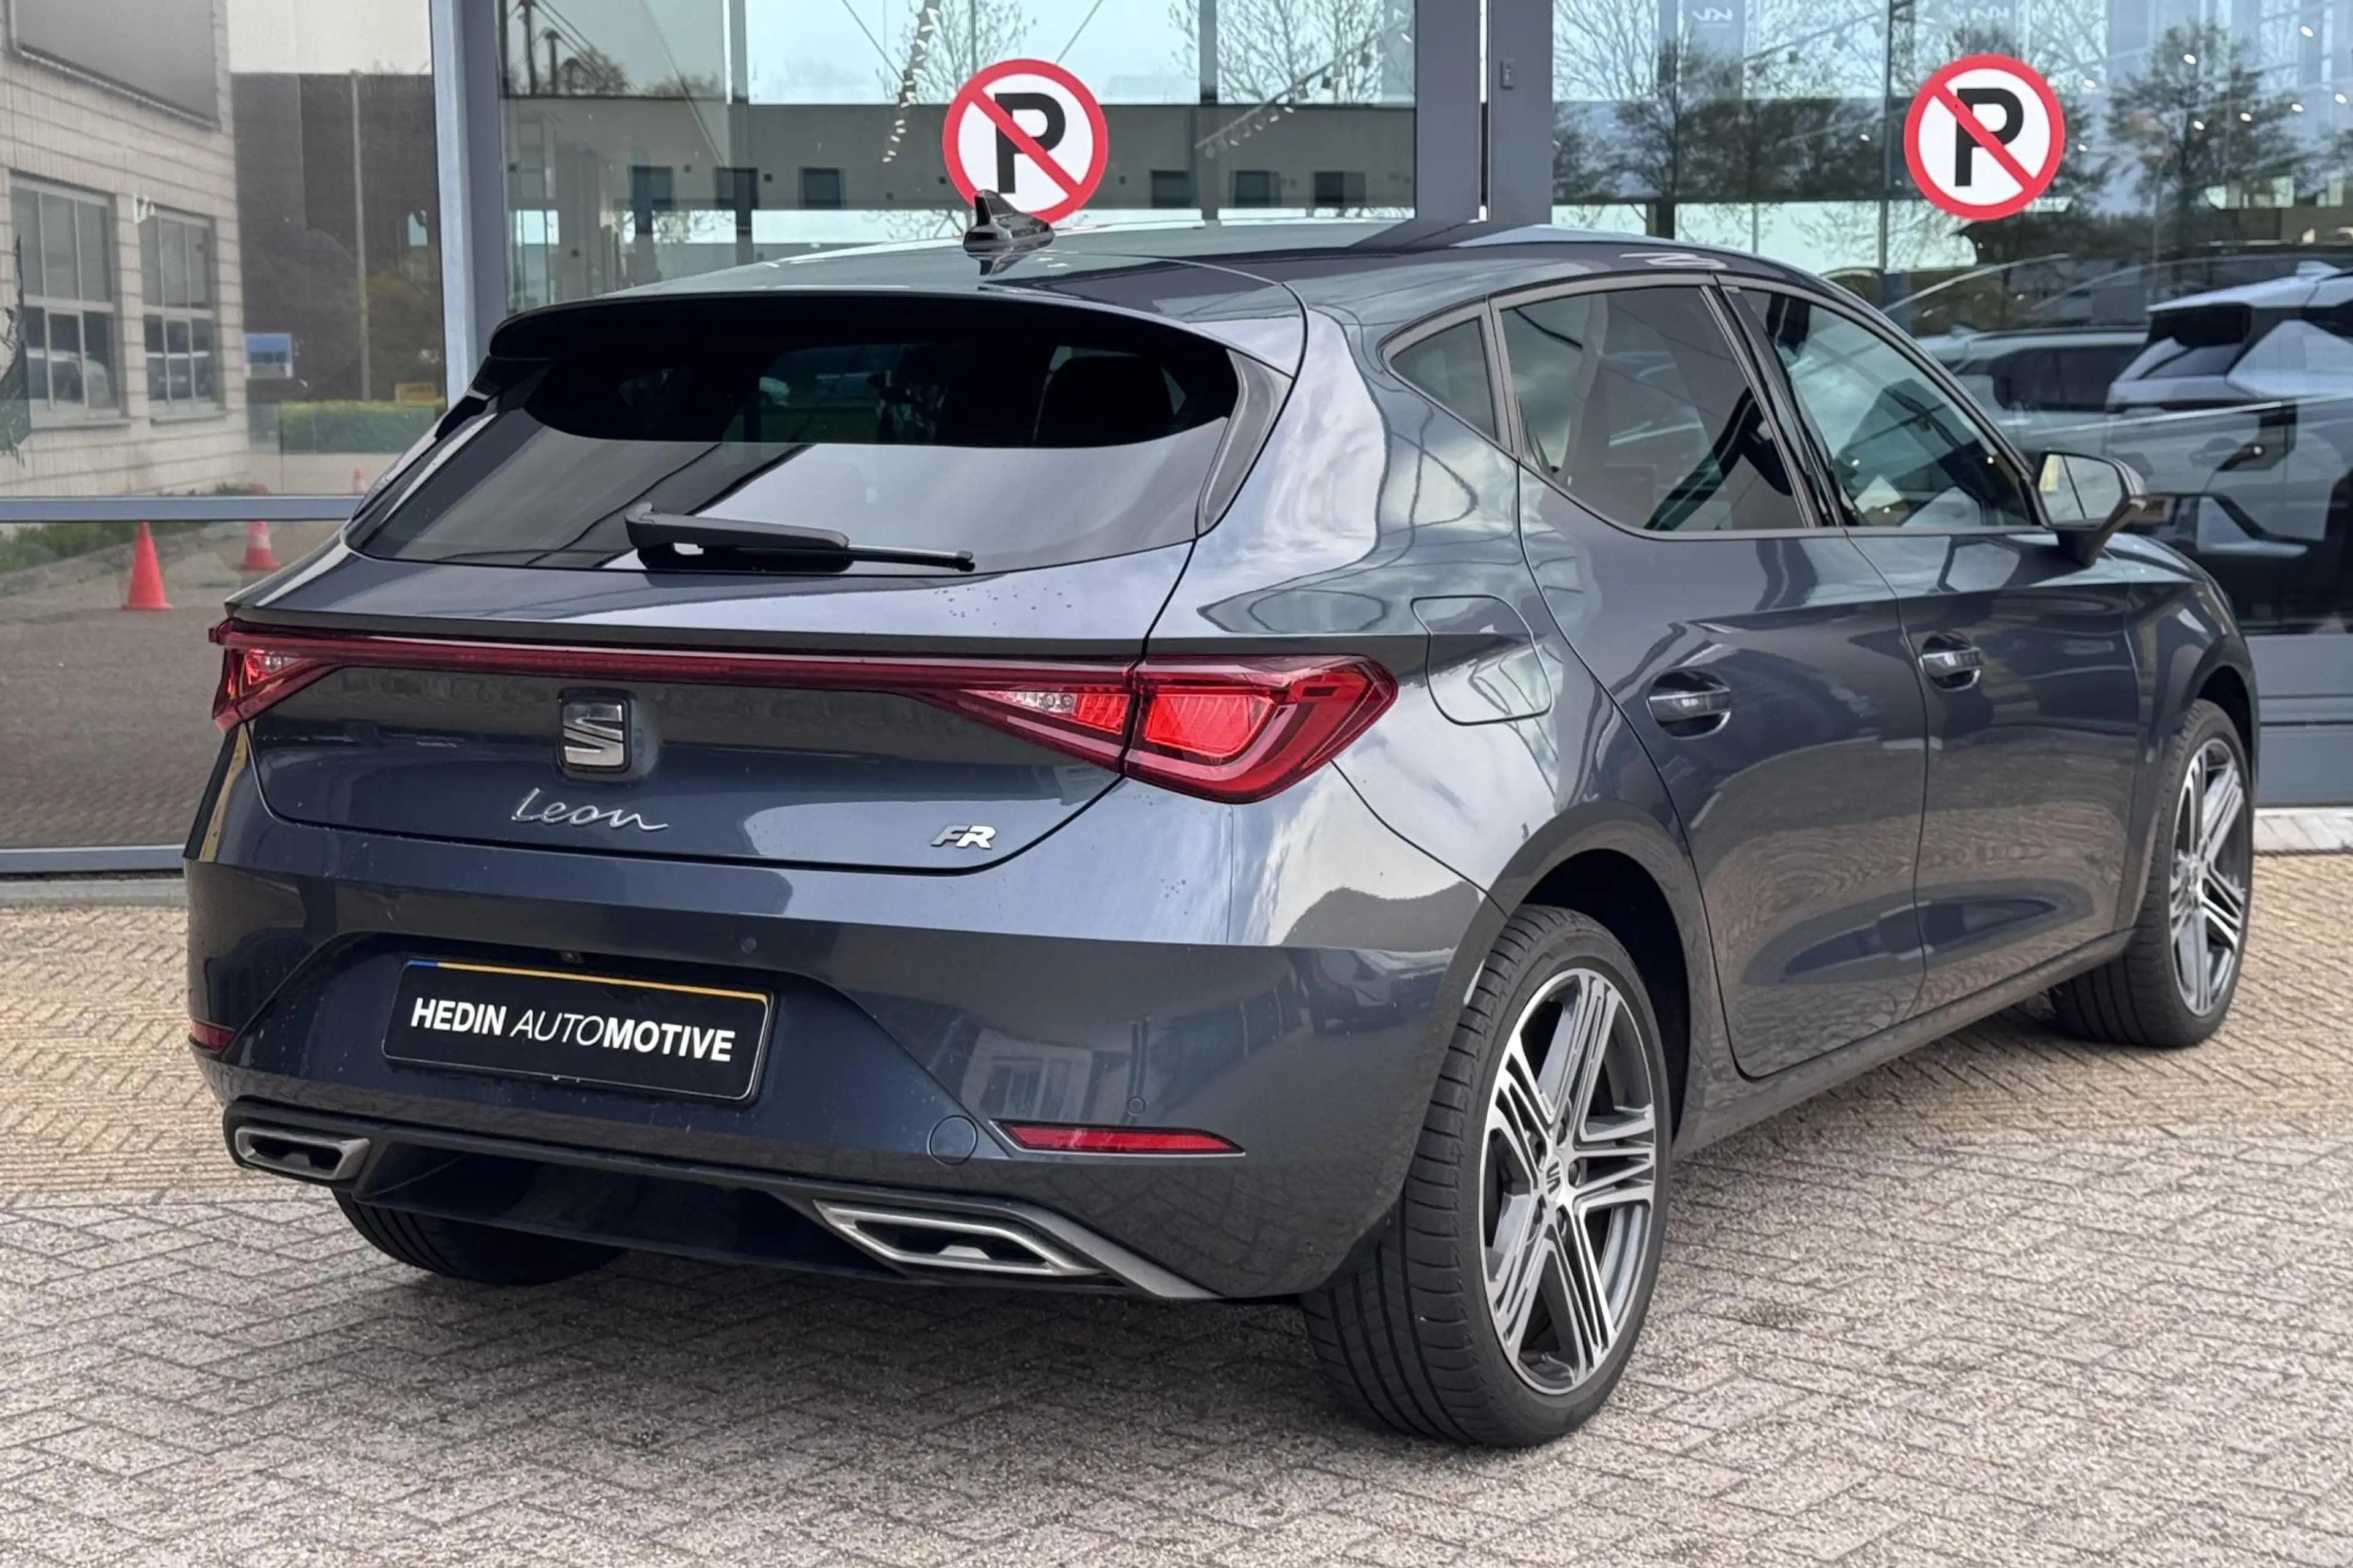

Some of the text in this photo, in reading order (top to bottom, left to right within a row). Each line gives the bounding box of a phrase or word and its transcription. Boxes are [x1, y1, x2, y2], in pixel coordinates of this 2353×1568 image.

[994, 93, 1066, 194] P
[1955, 88, 2023, 186] P
[512, 787, 669, 831] Leon
[931, 825, 996, 849] FR
[411, 997, 736, 1062] HEDIN AUTOMOTIVE
